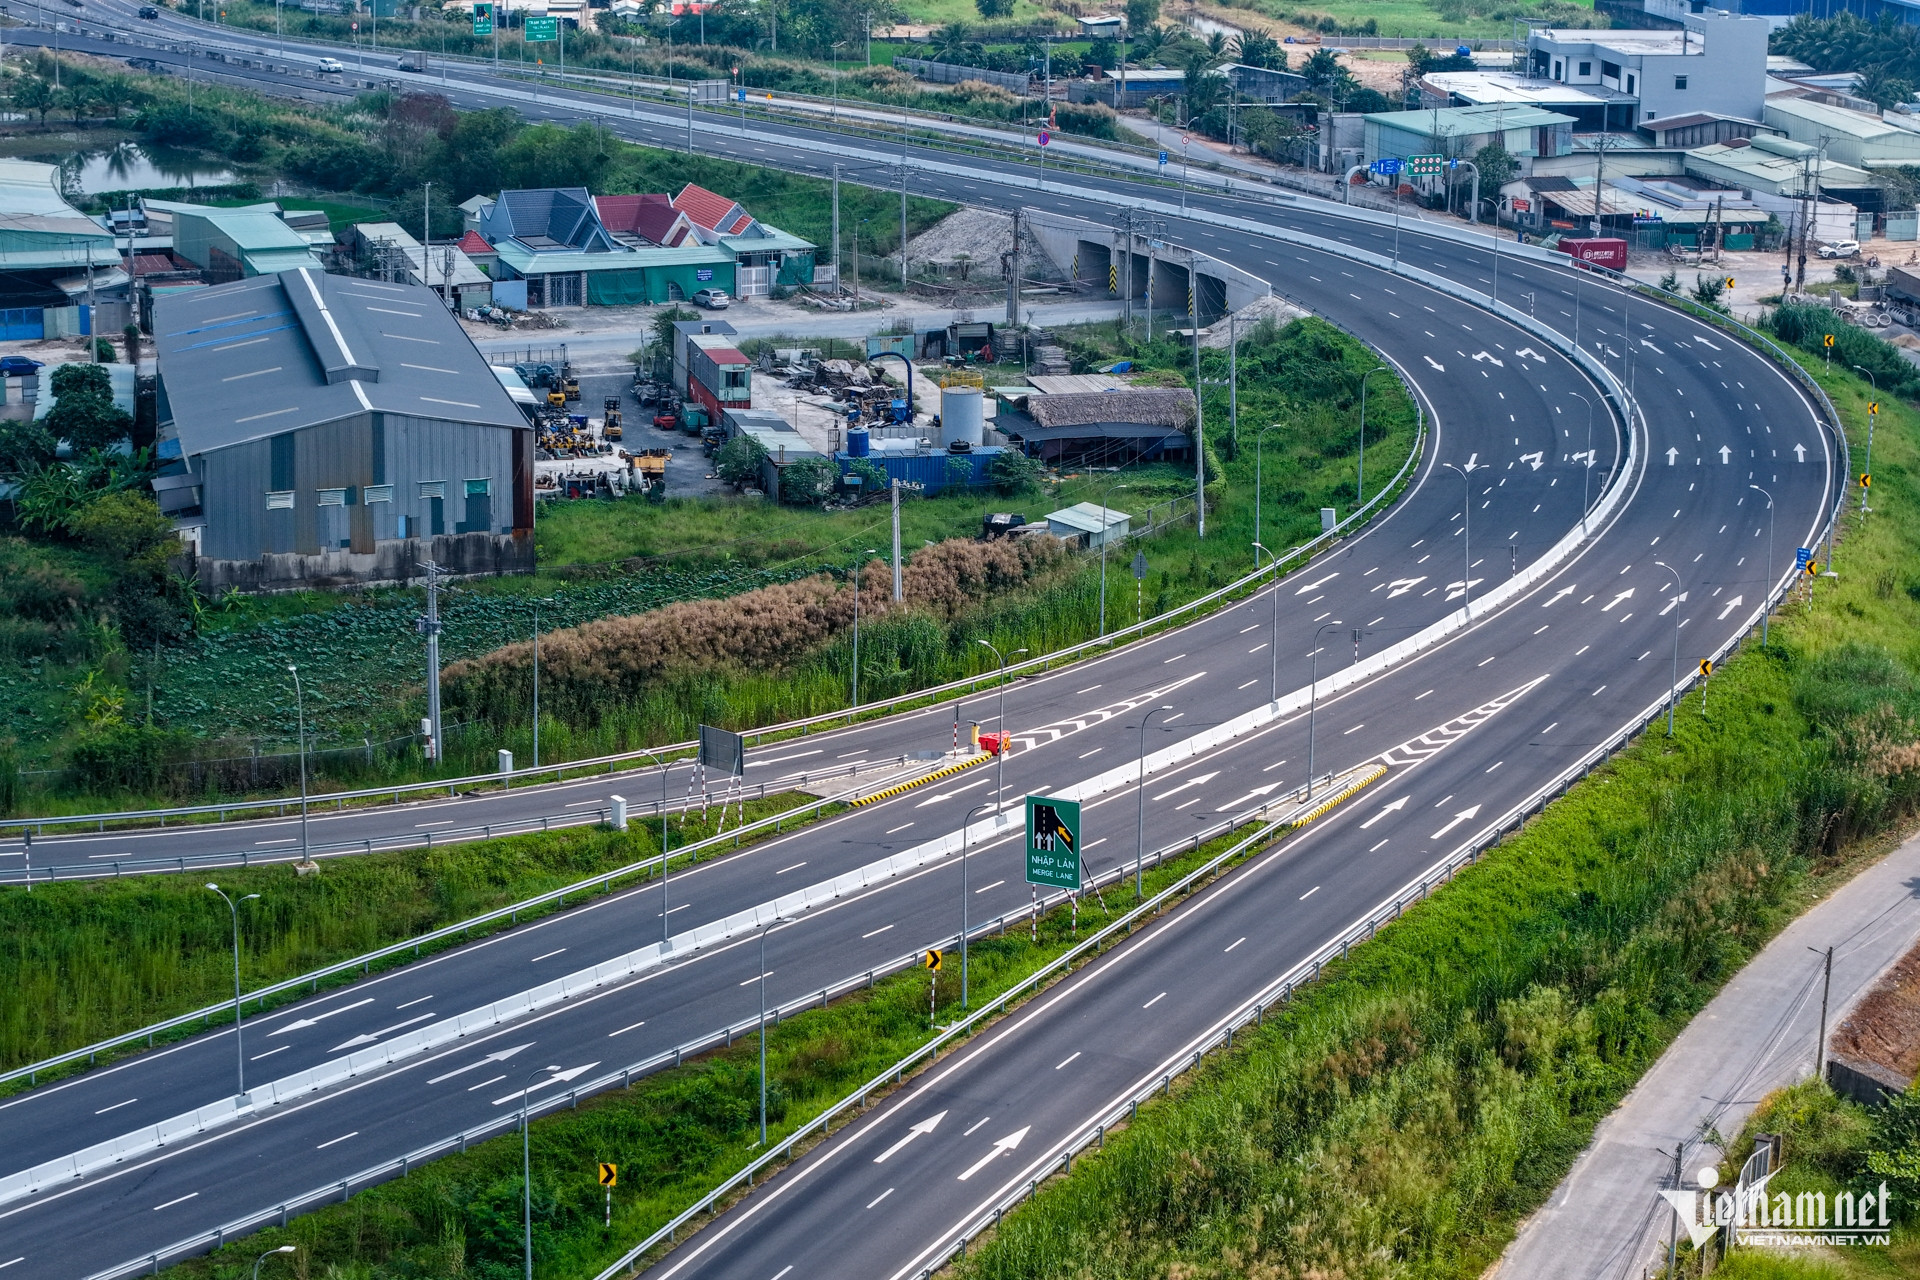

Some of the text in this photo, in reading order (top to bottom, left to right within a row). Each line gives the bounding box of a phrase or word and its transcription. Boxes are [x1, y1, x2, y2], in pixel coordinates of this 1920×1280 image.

[1031, 855, 1074, 869] NHẬP LÀN
[1032, 868, 1073, 880] MERGE LANE
